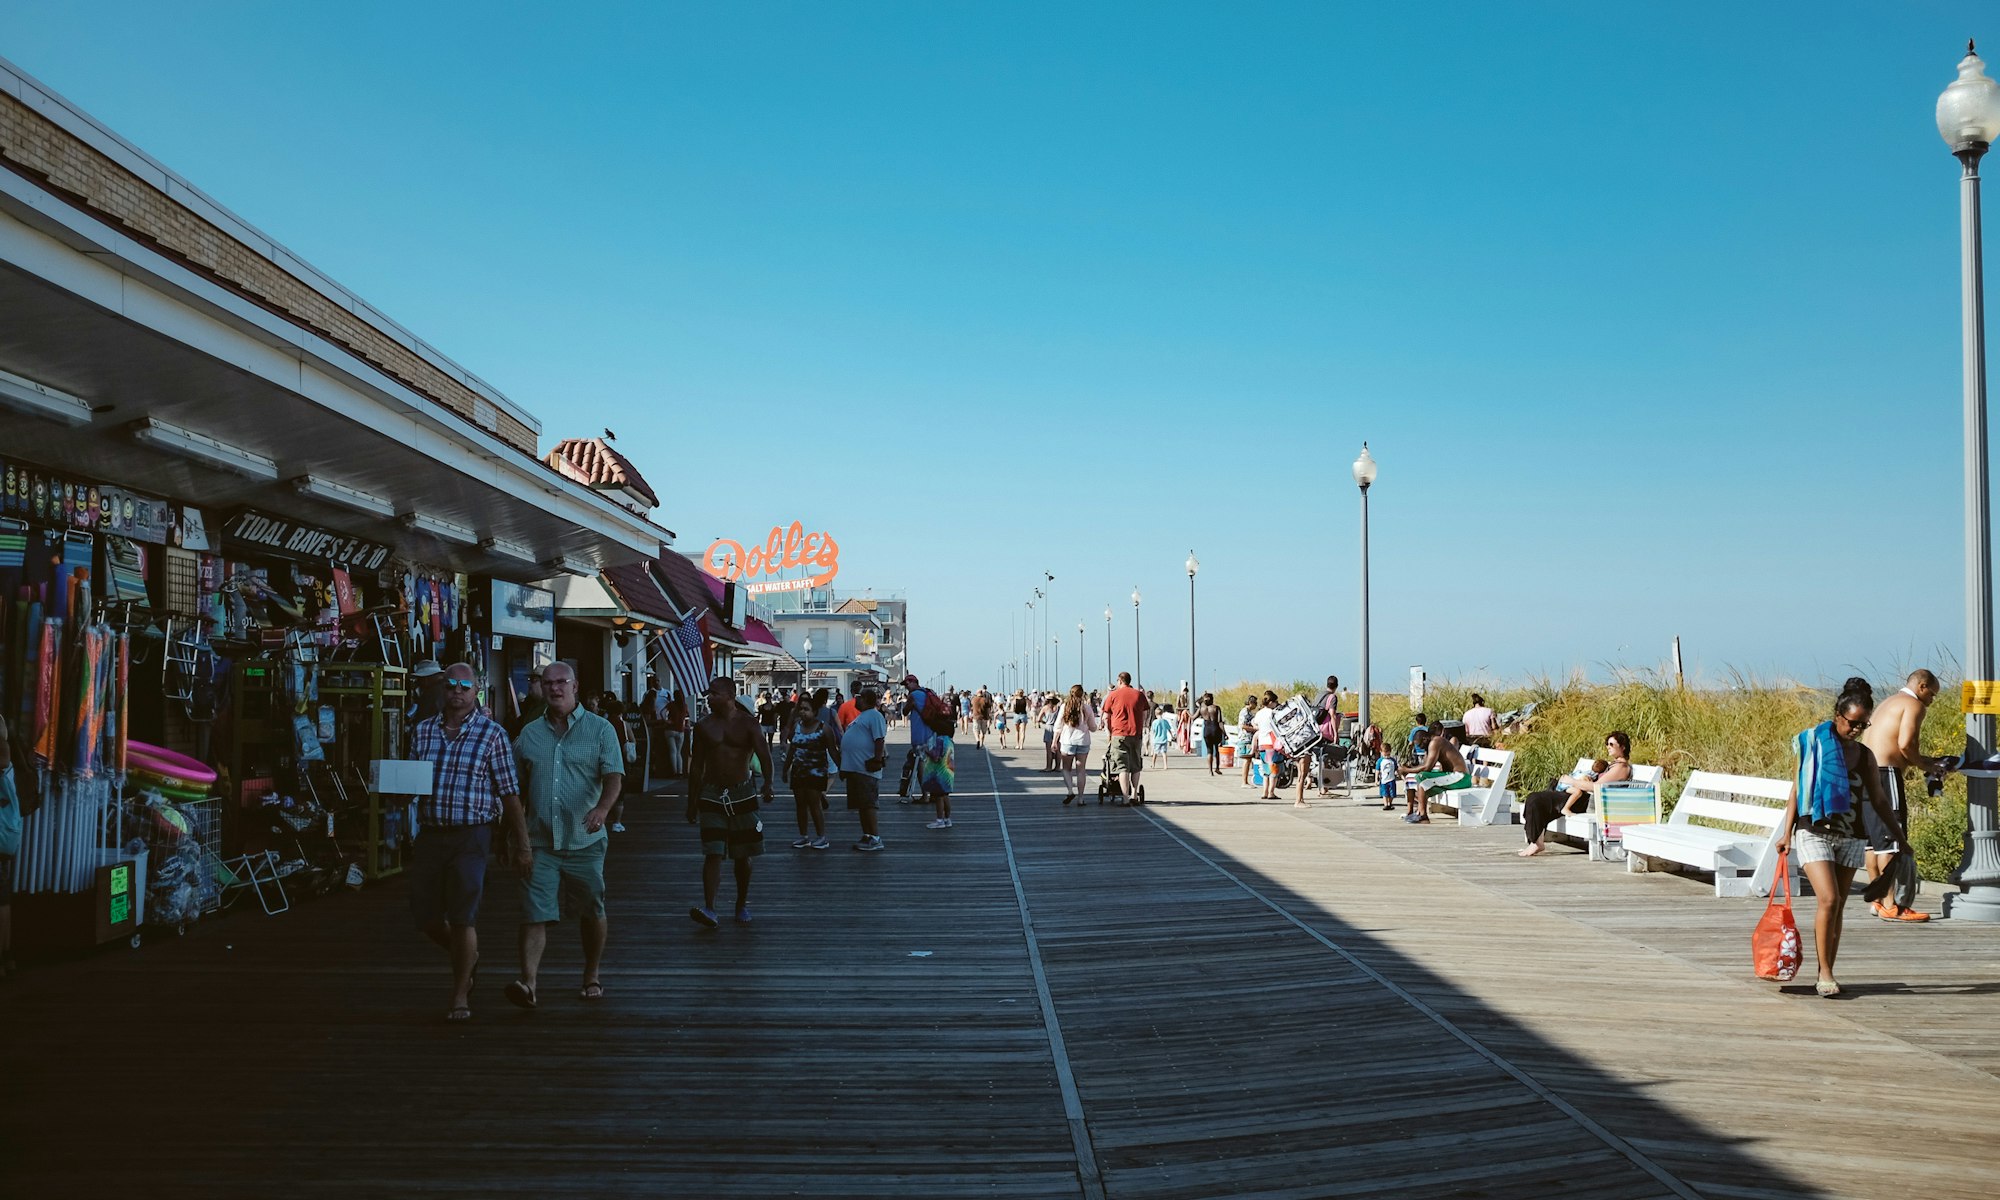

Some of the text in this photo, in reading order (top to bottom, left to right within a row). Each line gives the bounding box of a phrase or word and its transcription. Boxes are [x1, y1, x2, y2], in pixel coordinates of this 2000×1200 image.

[234, 513, 388, 570] TIDAL RAVE'S 5 & 10
[703, 519, 840, 581] Dolles
[746, 578, 815, 594] SALT WATER TAFFY
